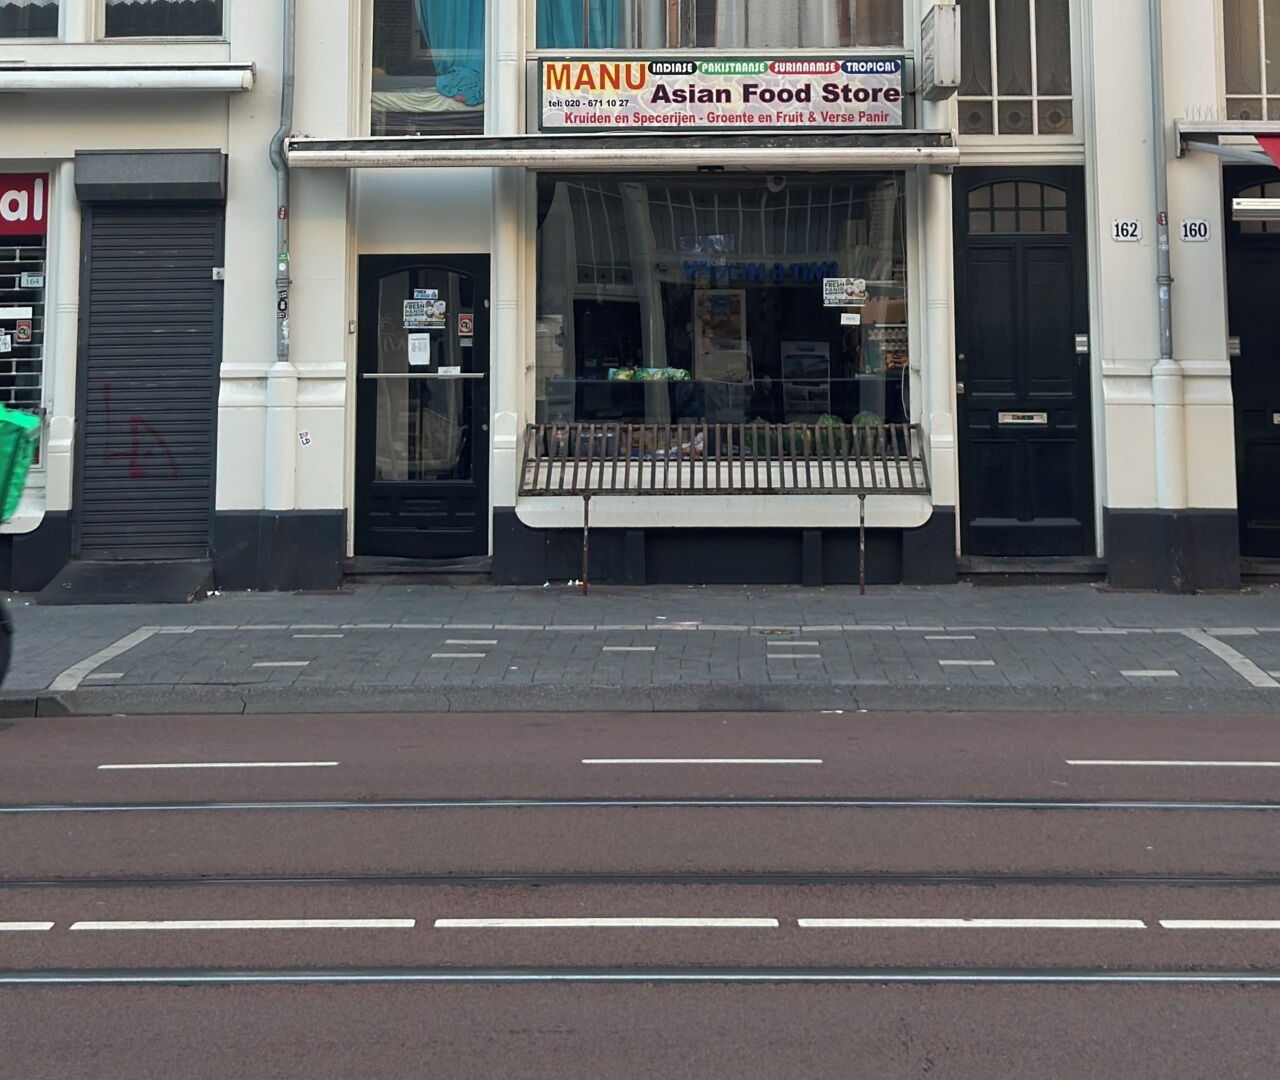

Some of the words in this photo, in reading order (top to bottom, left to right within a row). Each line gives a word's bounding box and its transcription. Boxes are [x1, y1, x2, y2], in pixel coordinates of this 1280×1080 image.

[652, 62, 693, 73] INDIASE
[701, 62, 765, 73] PAKISTAANSE
[774, 62, 836, 72] SURINAAMSE
[846, 62, 896, 72] TROPICAL
[546, 63, 646, 90] MANU
[650, 84, 732, 104] Asian
[742, 83, 811, 103] Food
[822, 83, 900, 103] Store
[564, 112, 611, 124] Kruiden
[617, 115, 629, 124] en
[633, 111, 696, 126] Specerijen
[706, 112, 754, 123] Groente
[758, 114, 772, 123] en
[776, 111, 804, 123] Fruit
[808, 111, 816, 123] &
[820, 111, 855, 123] Verse
[858, 111, 890, 123] Panir
[1114, 222, 1138, 238] 162
[1183, 222, 1208, 238] 160
[26, 278, 40, 286] 164
